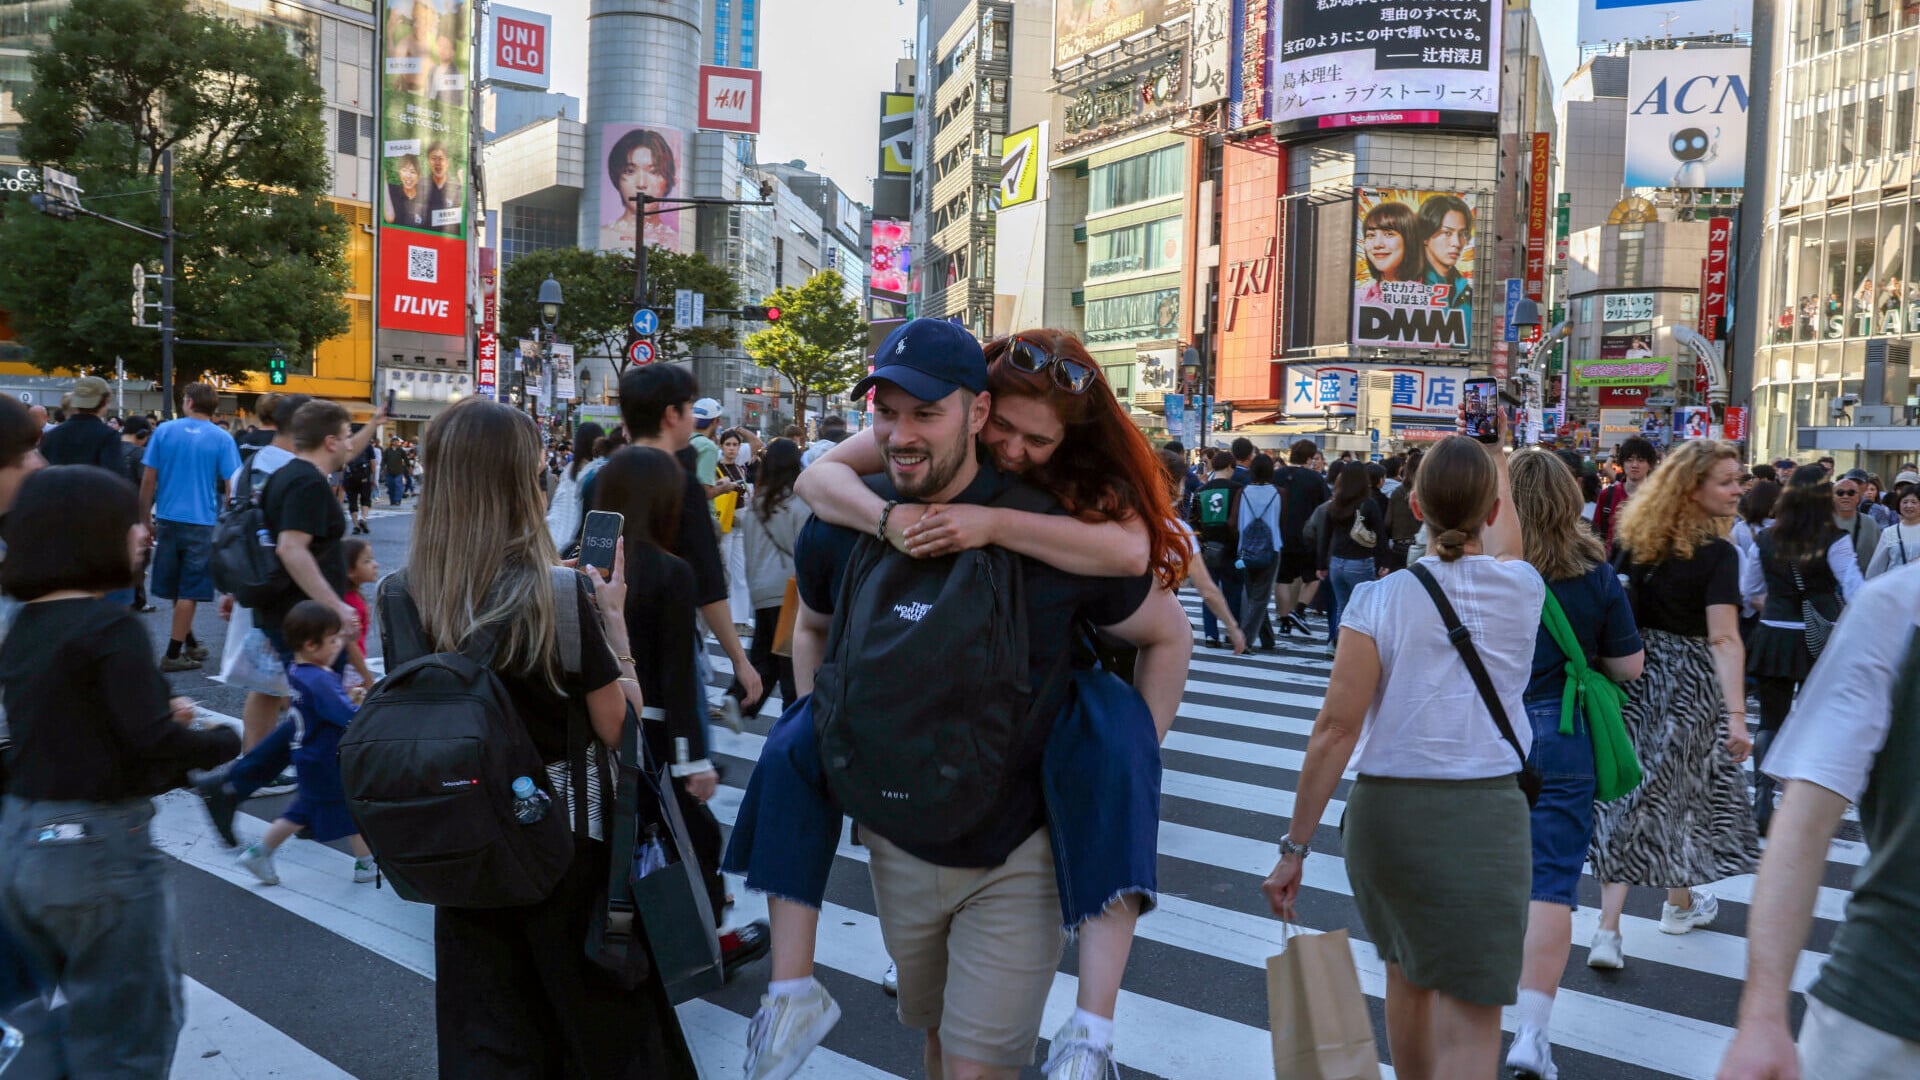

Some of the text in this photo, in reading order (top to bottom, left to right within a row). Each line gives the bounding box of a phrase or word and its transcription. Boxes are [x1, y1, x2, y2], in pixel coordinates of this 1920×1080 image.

[1380, 8, 1482, 22] 理由のすべてが、
[502, 24, 536, 47] UNI
[1283, 26, 1481, 55] 宝石のようにこの中で輝いている。
[502, 45, 539, 67] QLO
[1422, 47, 1483, 64] 辻村深月
[1282, 64, 1343, 90] 島本理生
[714, 88, 746, 110] H&M
[1275, 84, 1492, 113] 『グレー・ラブストーリーズ』
[1630, 75, 1749, 115] ACN
[1351, 113, 1403, 124] Rakuten Vision
[1527, 137, 1546, 294] クスリのことなら 三千里
[1224, 237, 1275, 331] クスリ
[1707, 228, 1726, 322] カラオケ
[1382, 283, 1432, 294] 幸せカナコの
[1383, 285, 1449, 306] 殺し屋生活 2
[394, 294, 449, 318] 17LIVE
[1617, 295, 1653, 306] れいわ
[1359, 306, 1466, 344] DMM
[1605, 309, 1653, 320] クリニック
[586, 537, 613, 548] 15:39
[894, 604, 927, 616] NORTH
[912, 601, 933, 610] THE
[900, 611, 922, 622] FACE
[881, 790, 909, 800] VAULT
